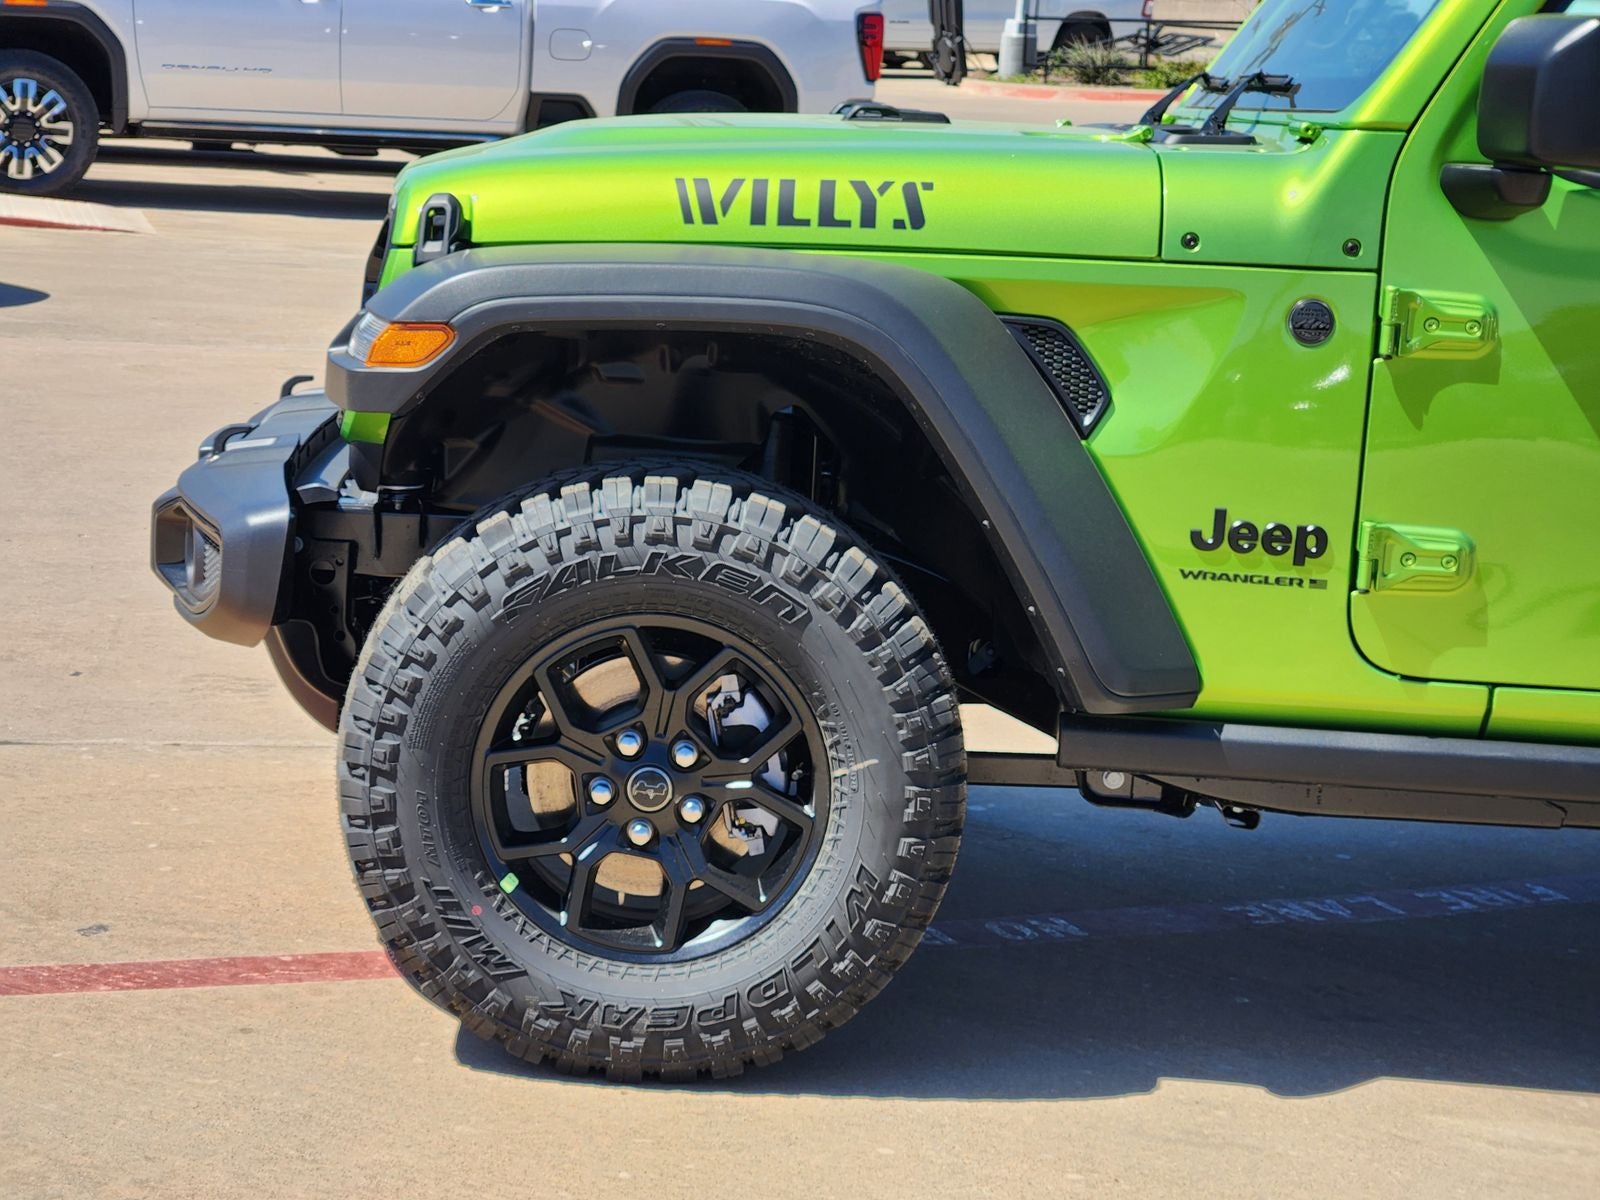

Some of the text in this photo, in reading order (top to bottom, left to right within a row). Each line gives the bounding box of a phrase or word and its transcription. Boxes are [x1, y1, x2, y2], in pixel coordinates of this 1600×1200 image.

[674, 177, 935, 231] WILLYS
[1190, 507, 1329, 567] Jeep
[1179, 568, 1305, 589] WRANGLER
[538, 861, 881, 1032] WILDPEAK
